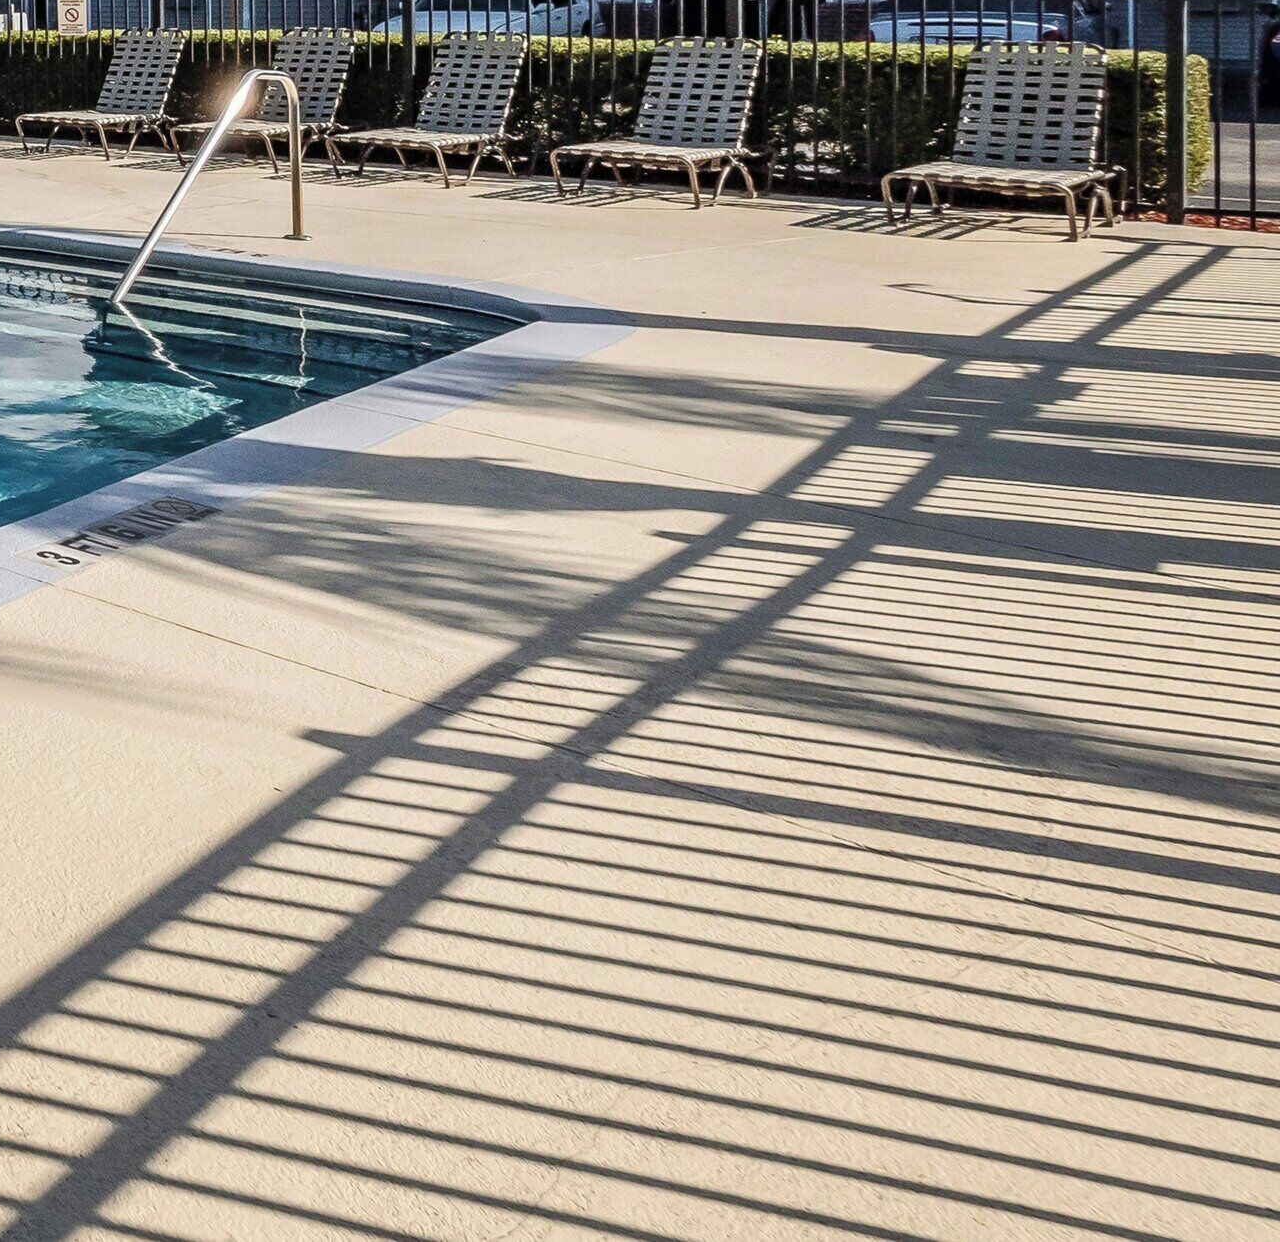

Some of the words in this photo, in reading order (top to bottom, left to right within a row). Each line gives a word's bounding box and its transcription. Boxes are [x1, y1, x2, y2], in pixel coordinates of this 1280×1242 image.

[122, 510, 183, 531] IN
[100, 524, 146, 540] 6
[60, 533, 120, 557] FT
[36, 551, 80, 565] 3
